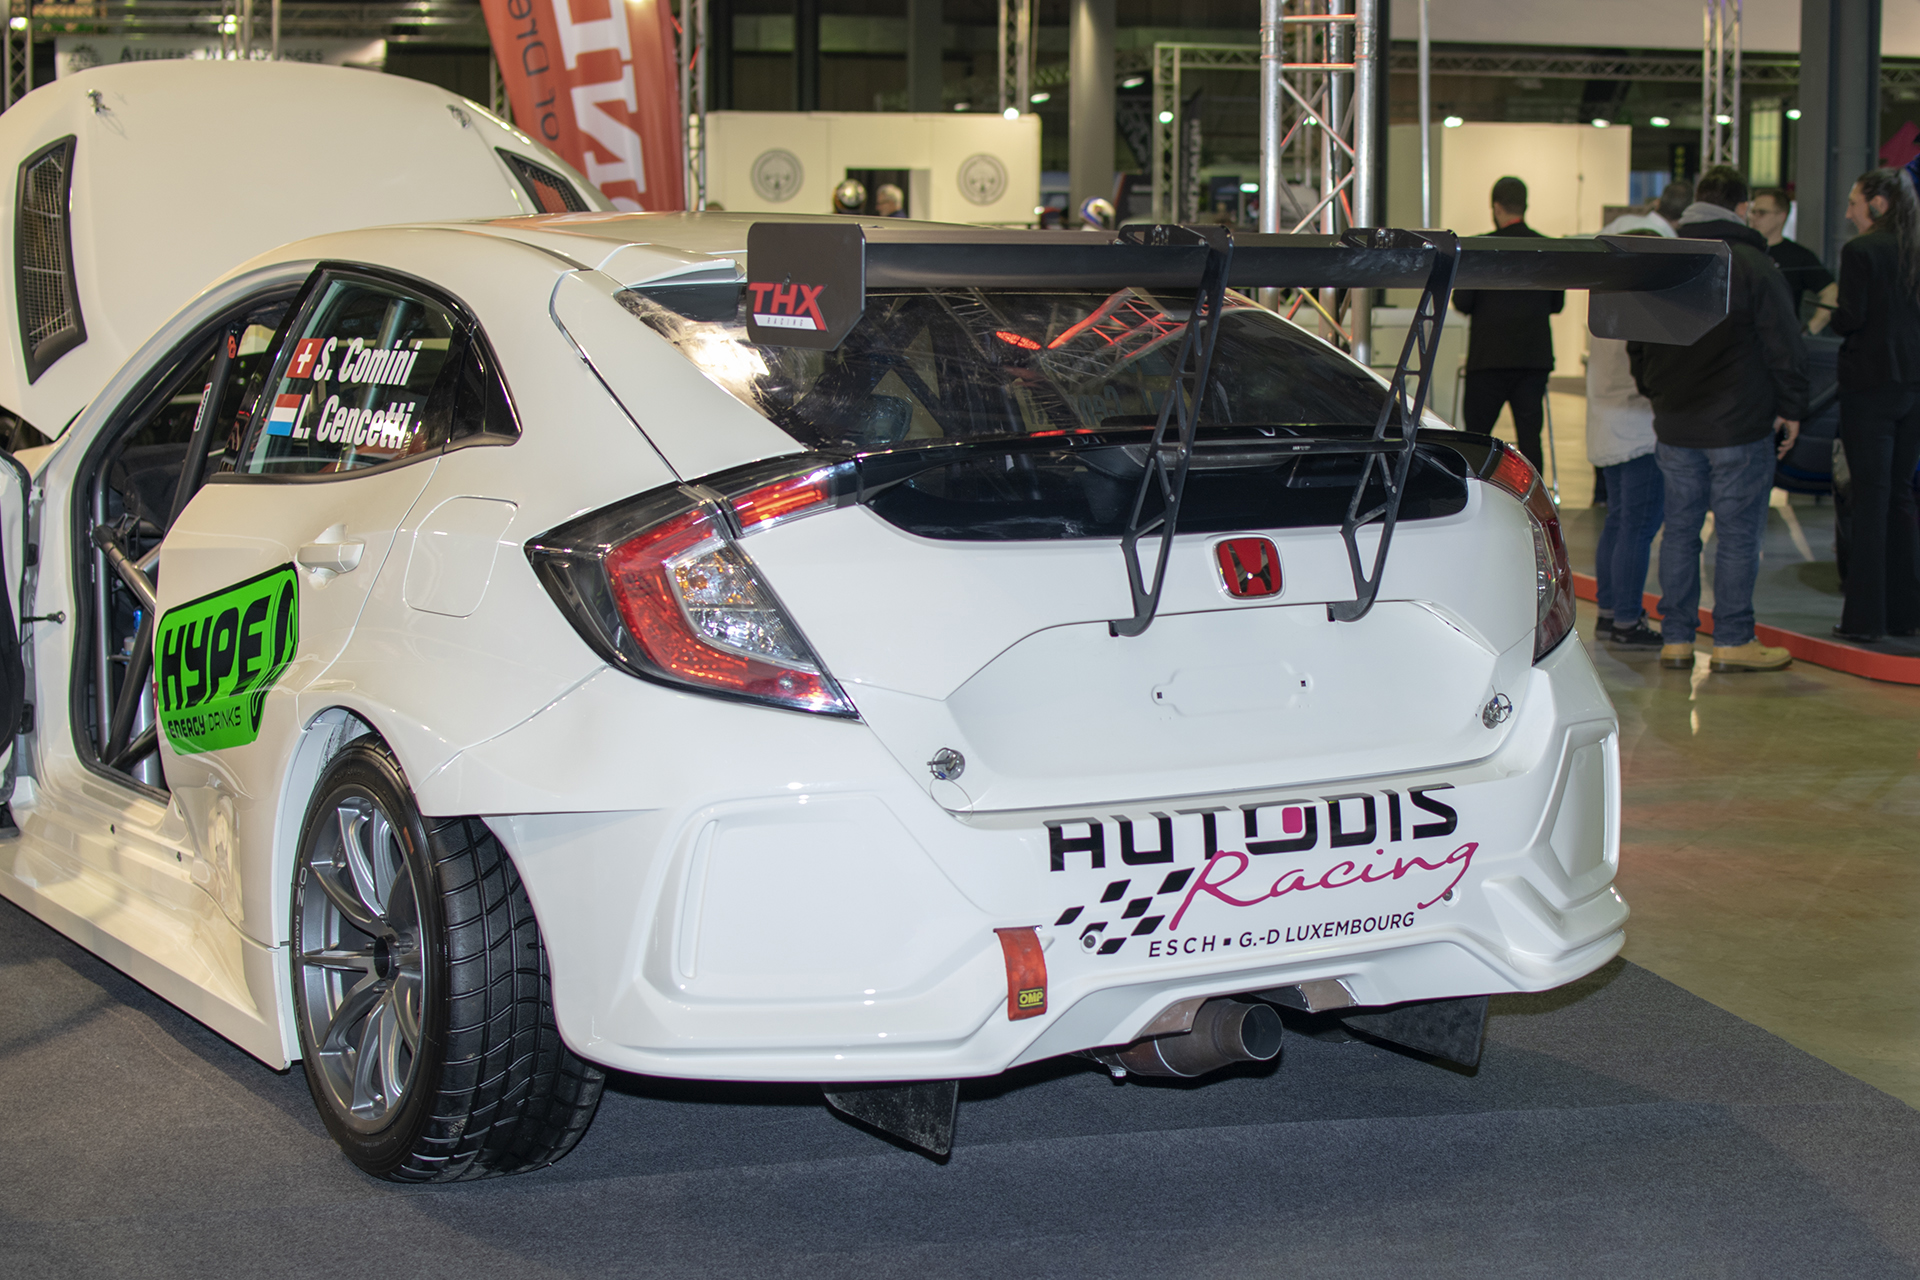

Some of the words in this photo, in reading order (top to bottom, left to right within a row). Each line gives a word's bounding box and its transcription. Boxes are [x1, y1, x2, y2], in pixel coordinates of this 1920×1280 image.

[748, 282, 827, 331] THX
[313, 336, 338, 381] S.
[338, 337, 423, 386] Comini
[292, 394, 311, 440] L.
[316, 395, 416, 449] Cencetti
[161, 594, 272, 712] HYPE
[208, 706, 242, 732] DRINKS
[1043, 782, 1459, 872] AUTODIS
[1169, 842, 1479, 932] Racing
[1149, 935, 1216, 958] ESCH
[1285, 911, 1415, 943] LUXEMBOURG
[1019, 991, 1044, 1004] OMP
